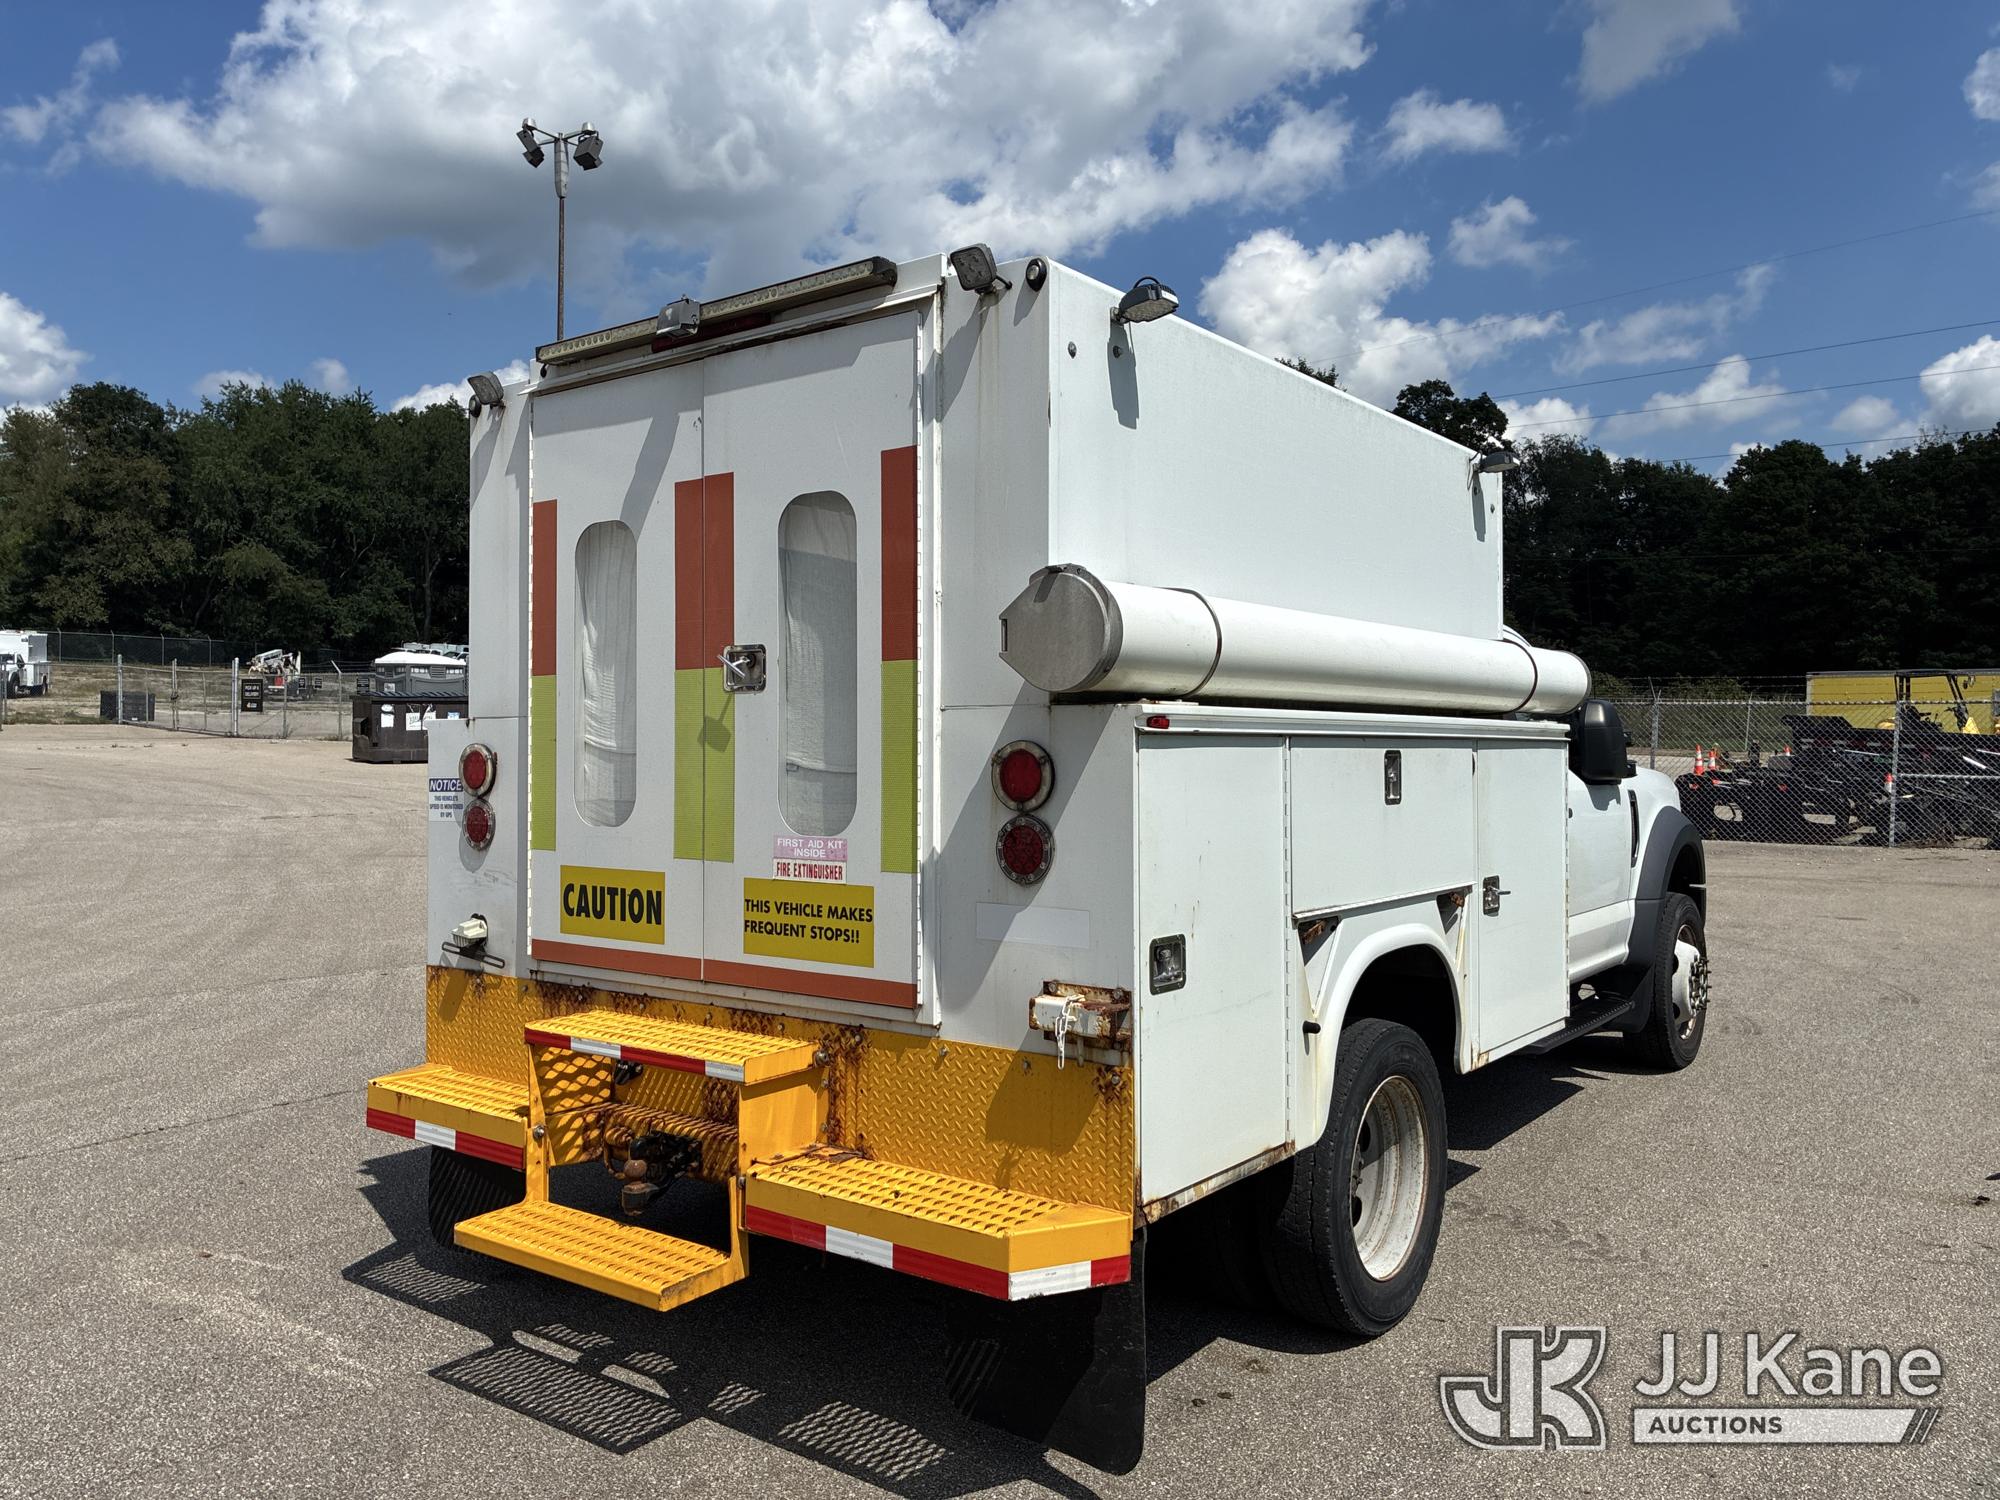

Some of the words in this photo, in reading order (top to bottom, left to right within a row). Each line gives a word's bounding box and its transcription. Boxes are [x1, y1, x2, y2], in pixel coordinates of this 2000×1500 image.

[430, 779, 462, 791] NOTICE
[777, 838, 804, 848] FIRST
[808, 840, 824, 849] AID
[827, 840, 844, 849] KIT
[794, 848, 826, 858] INSIDE
[776, 862, 791, 877] FIRE
[793, 863, 843, 881] EXTINGUISHER
[563, 883, 662, 925] CAUTION
[744, 899, 771, 913] THIS
[774, 901, 823, 918] VEHICLE
[827, 905, 873, 922] MAKES
[744, 919, 807, 938] FREQUENT
[810, 925, 860, 944] STOPS!!
